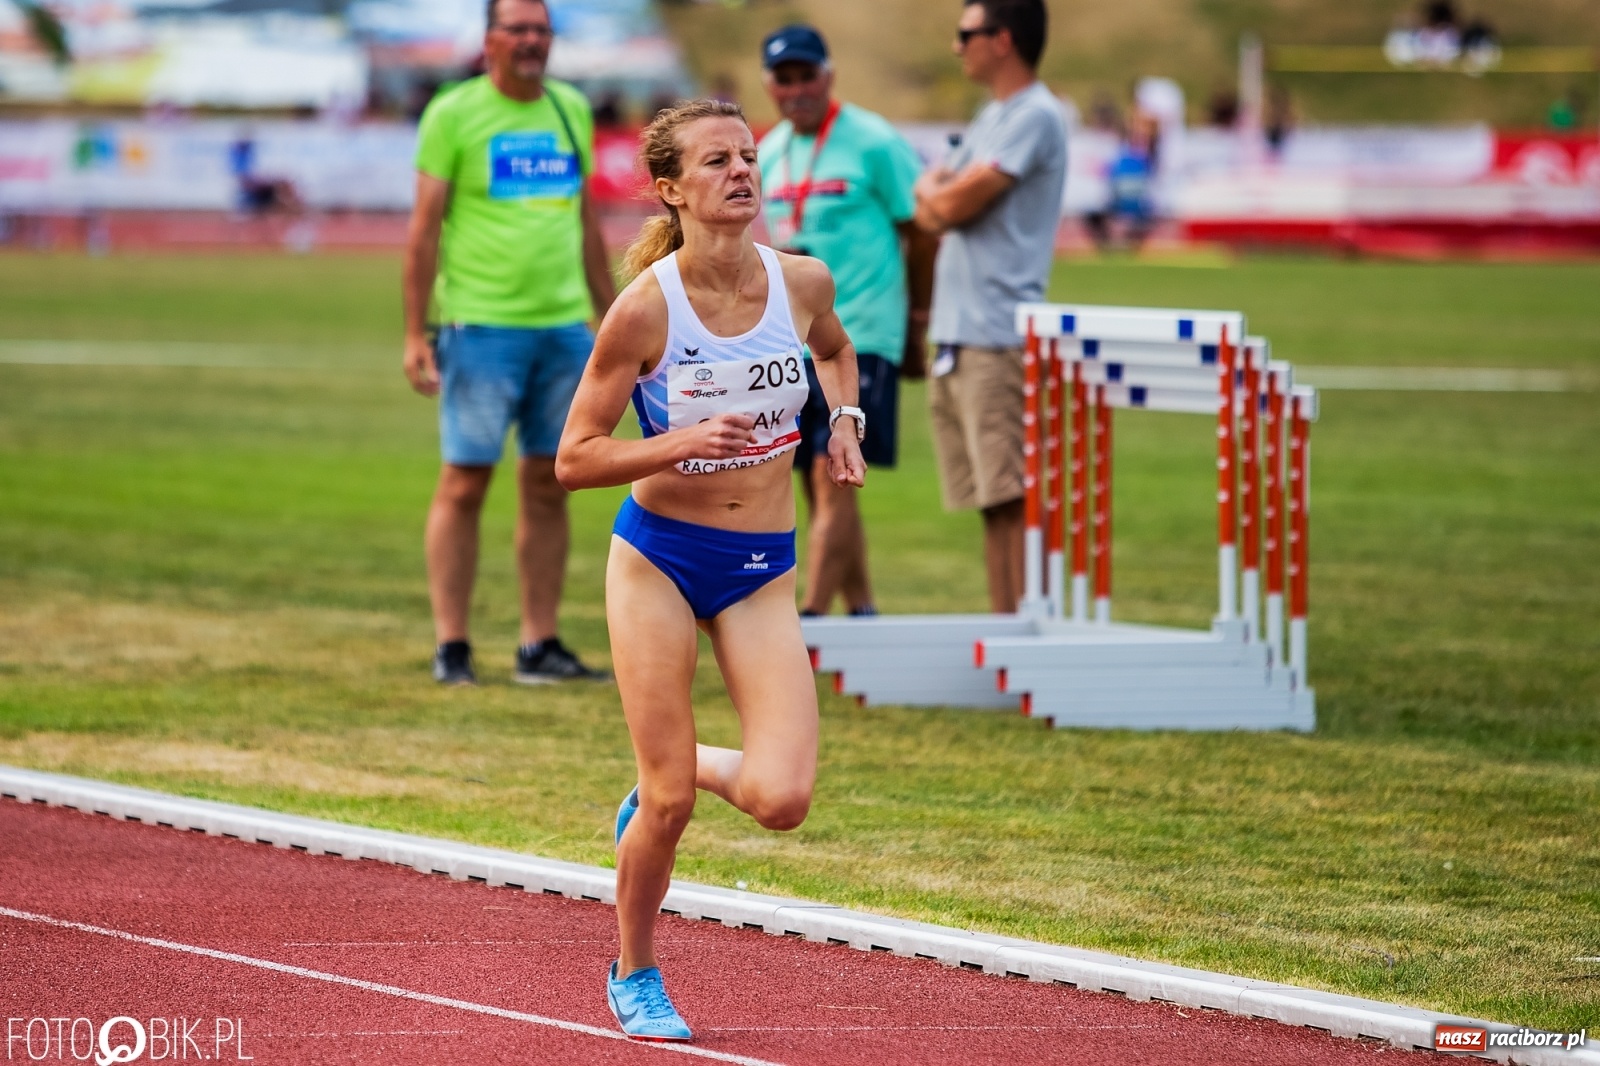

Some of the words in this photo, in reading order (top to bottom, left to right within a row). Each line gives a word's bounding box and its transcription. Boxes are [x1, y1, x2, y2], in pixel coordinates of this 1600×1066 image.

[511, 156, 569, 176] TEAM
[748, 357, 800, 391] 203
[743, 562, 769, 570] erima
